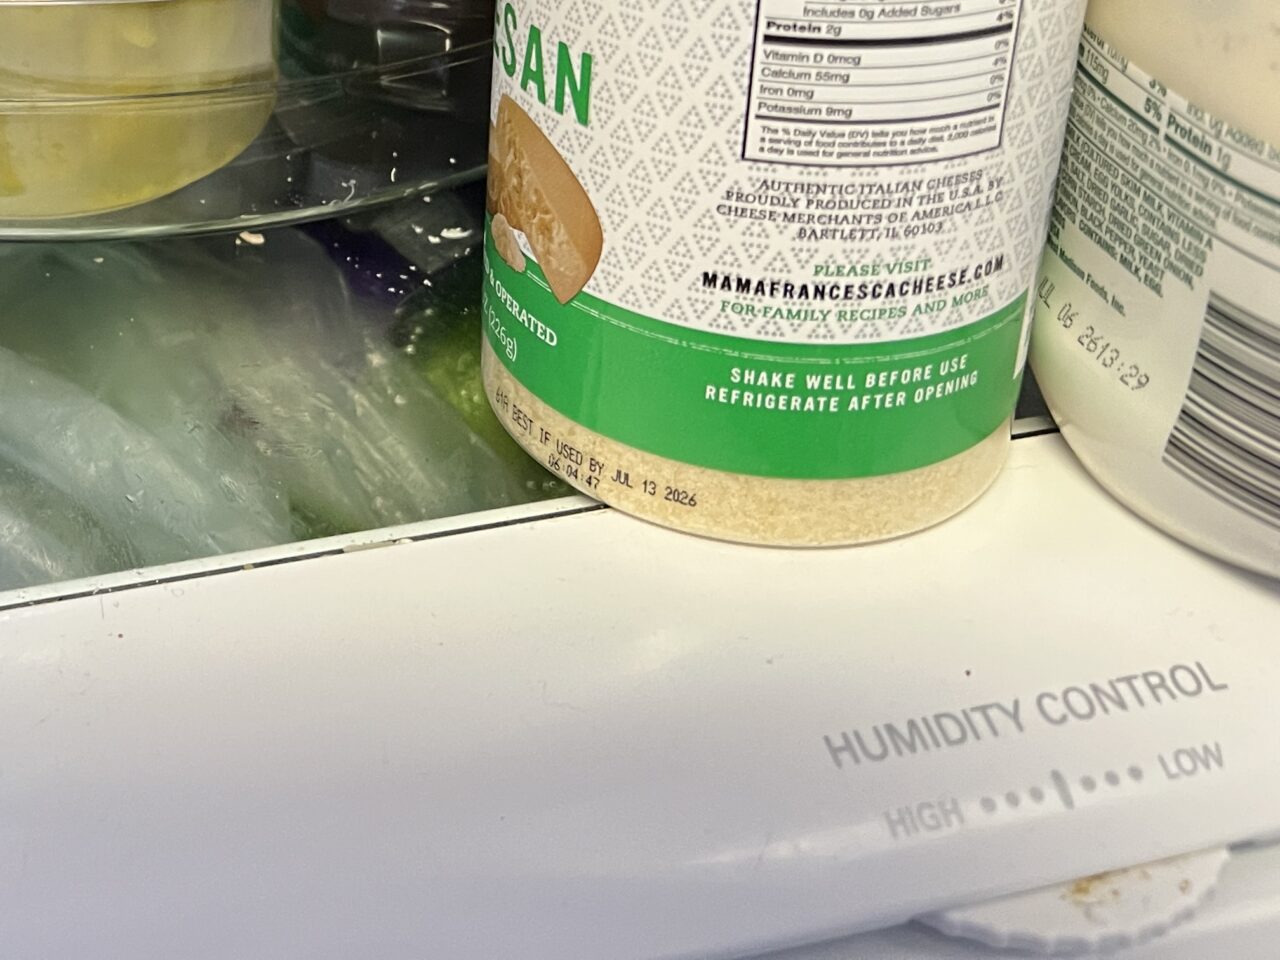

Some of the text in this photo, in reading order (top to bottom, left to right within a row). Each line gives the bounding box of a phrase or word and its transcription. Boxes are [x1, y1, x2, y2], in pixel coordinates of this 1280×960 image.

[765, 21, 842, 36] Protein 2g
[803, 3, 962, 20] Includes 0g Added Sugars
[763, 49, 862, 66] Vitamin D 0mcg
[761, 67, 850, 83] Calcium 55mg
[759, 85, 814, 100] Iron 0mg
[757, 102, 853, 118] Potassium 9mg
[1143, 97, 1163, 122] 5%
[1167, 113, 1213, 157] Protein
[724, 190, 800, 209] PROUDLY
[805, 197, 892, 210] PRODUCED
[896, 196, 914, 209] IN
[917, 192, 946, 206] THE
[987, 176, 1004, 190] BY
[758, 169, 983, 197] AUTHENTIC ITALIAN CHEESES
[1120, 173, 1141, 198] SKIM
[716, 204, 777, 221] CHEESE
[782, 211, 883, 225] MERCHANTS
[887, 212, 908, 225] OF
[911, 202, 971, 222] AMERICA
[797, 221, 944, 241] BARTLETT, IL 60103
[702, 254, 1004, 301] MAMAFRANCESCACHEESE.COM
[812, 258, 931, 277] PLEASE VISIT
[495, 280, 558, 347] OPERATED
[720, 286, 989, 322] FOR FAMILY RECIPES AND MORE
[1037, 275, 1057, 310] UL
[1057, 302, 1080, 330] 06
[488, 305, 518, 362] (226g)
[730, 353, 969, 390] SHAKE WELL BEFORE USE
[705, 370, 979, 413] REFRIGERATE AFTER OPENING
[512, 404, 534, 435] BEST
[539, 428, 552, 444] IF
[556, 439, 584, 466] USED
[589, 457, 605, 475] BY
[611, 469, 634, 489] JUL
[642, 479, 657, 496] 13
[663, 485, 697, 507] 2026
[823, 660, 1228, 769] HUMIDITY CONTROL
[882, 742, 1225, 841] HIGH LOW
